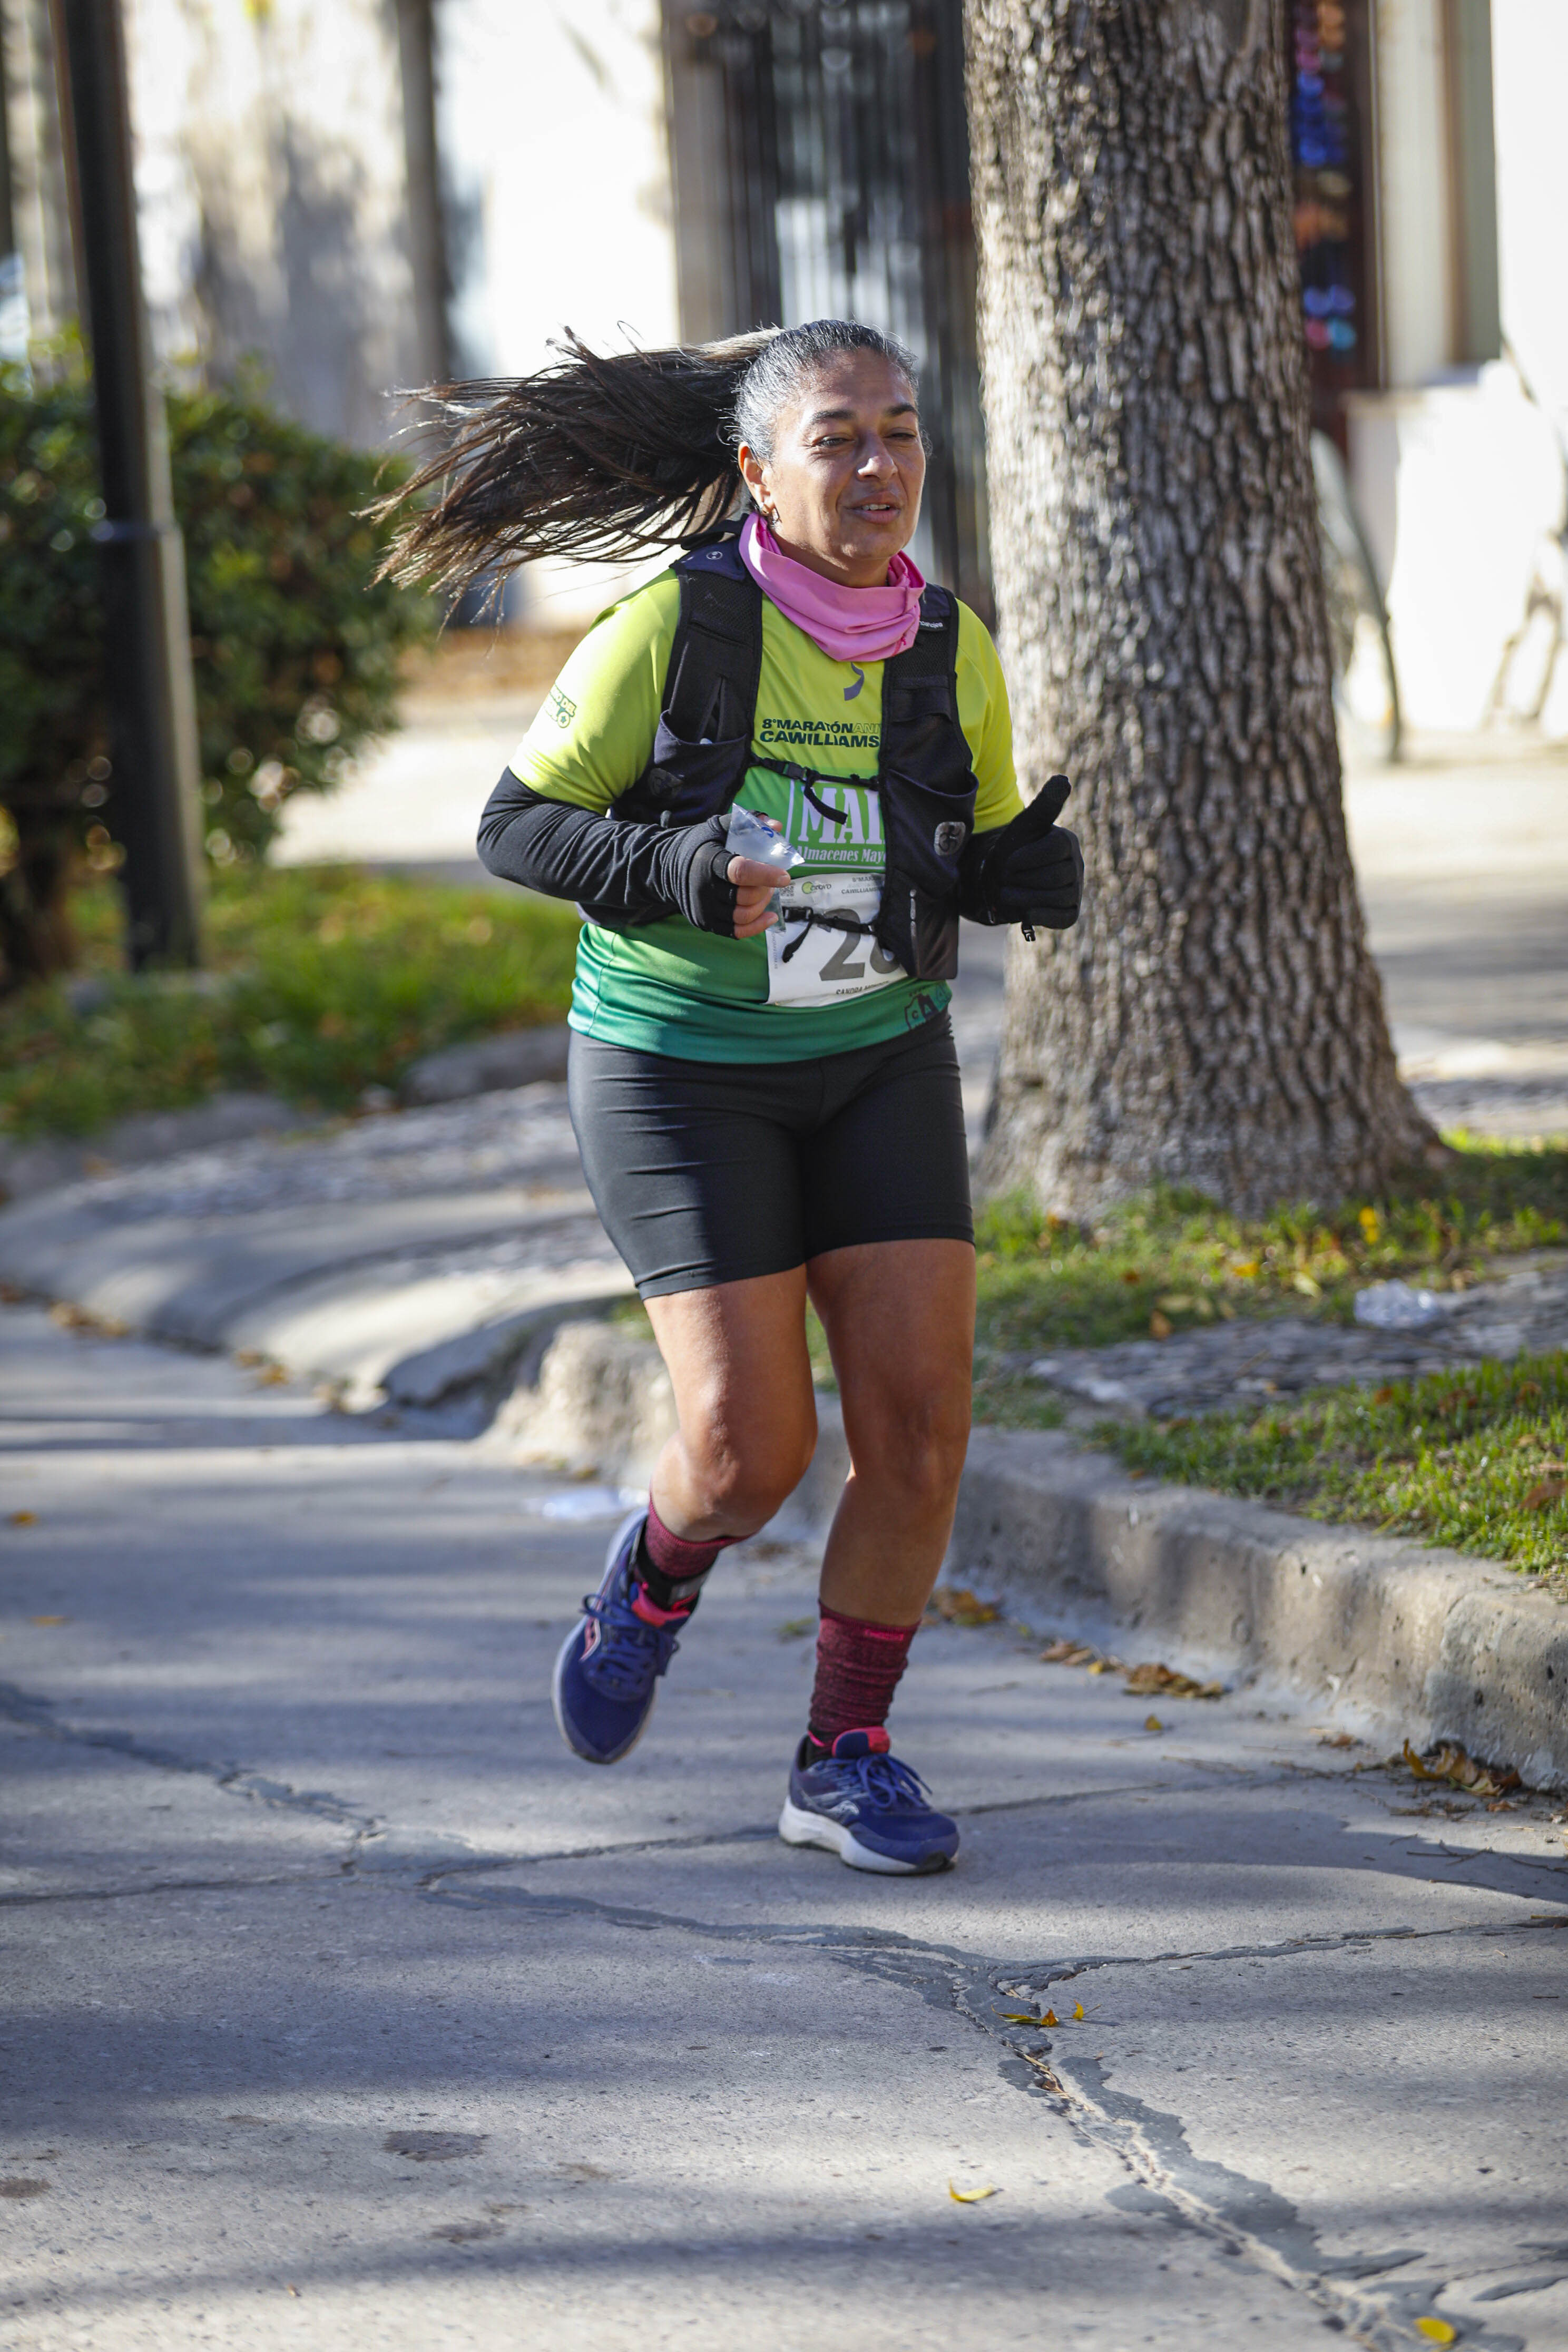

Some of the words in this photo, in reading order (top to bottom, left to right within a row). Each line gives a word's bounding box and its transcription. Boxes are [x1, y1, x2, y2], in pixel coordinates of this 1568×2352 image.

[853, 722, 881, 734] ANI
[760, 730, 880, 748] CAWILLIAMS
[797, 845, 858, 861] Almacenes
